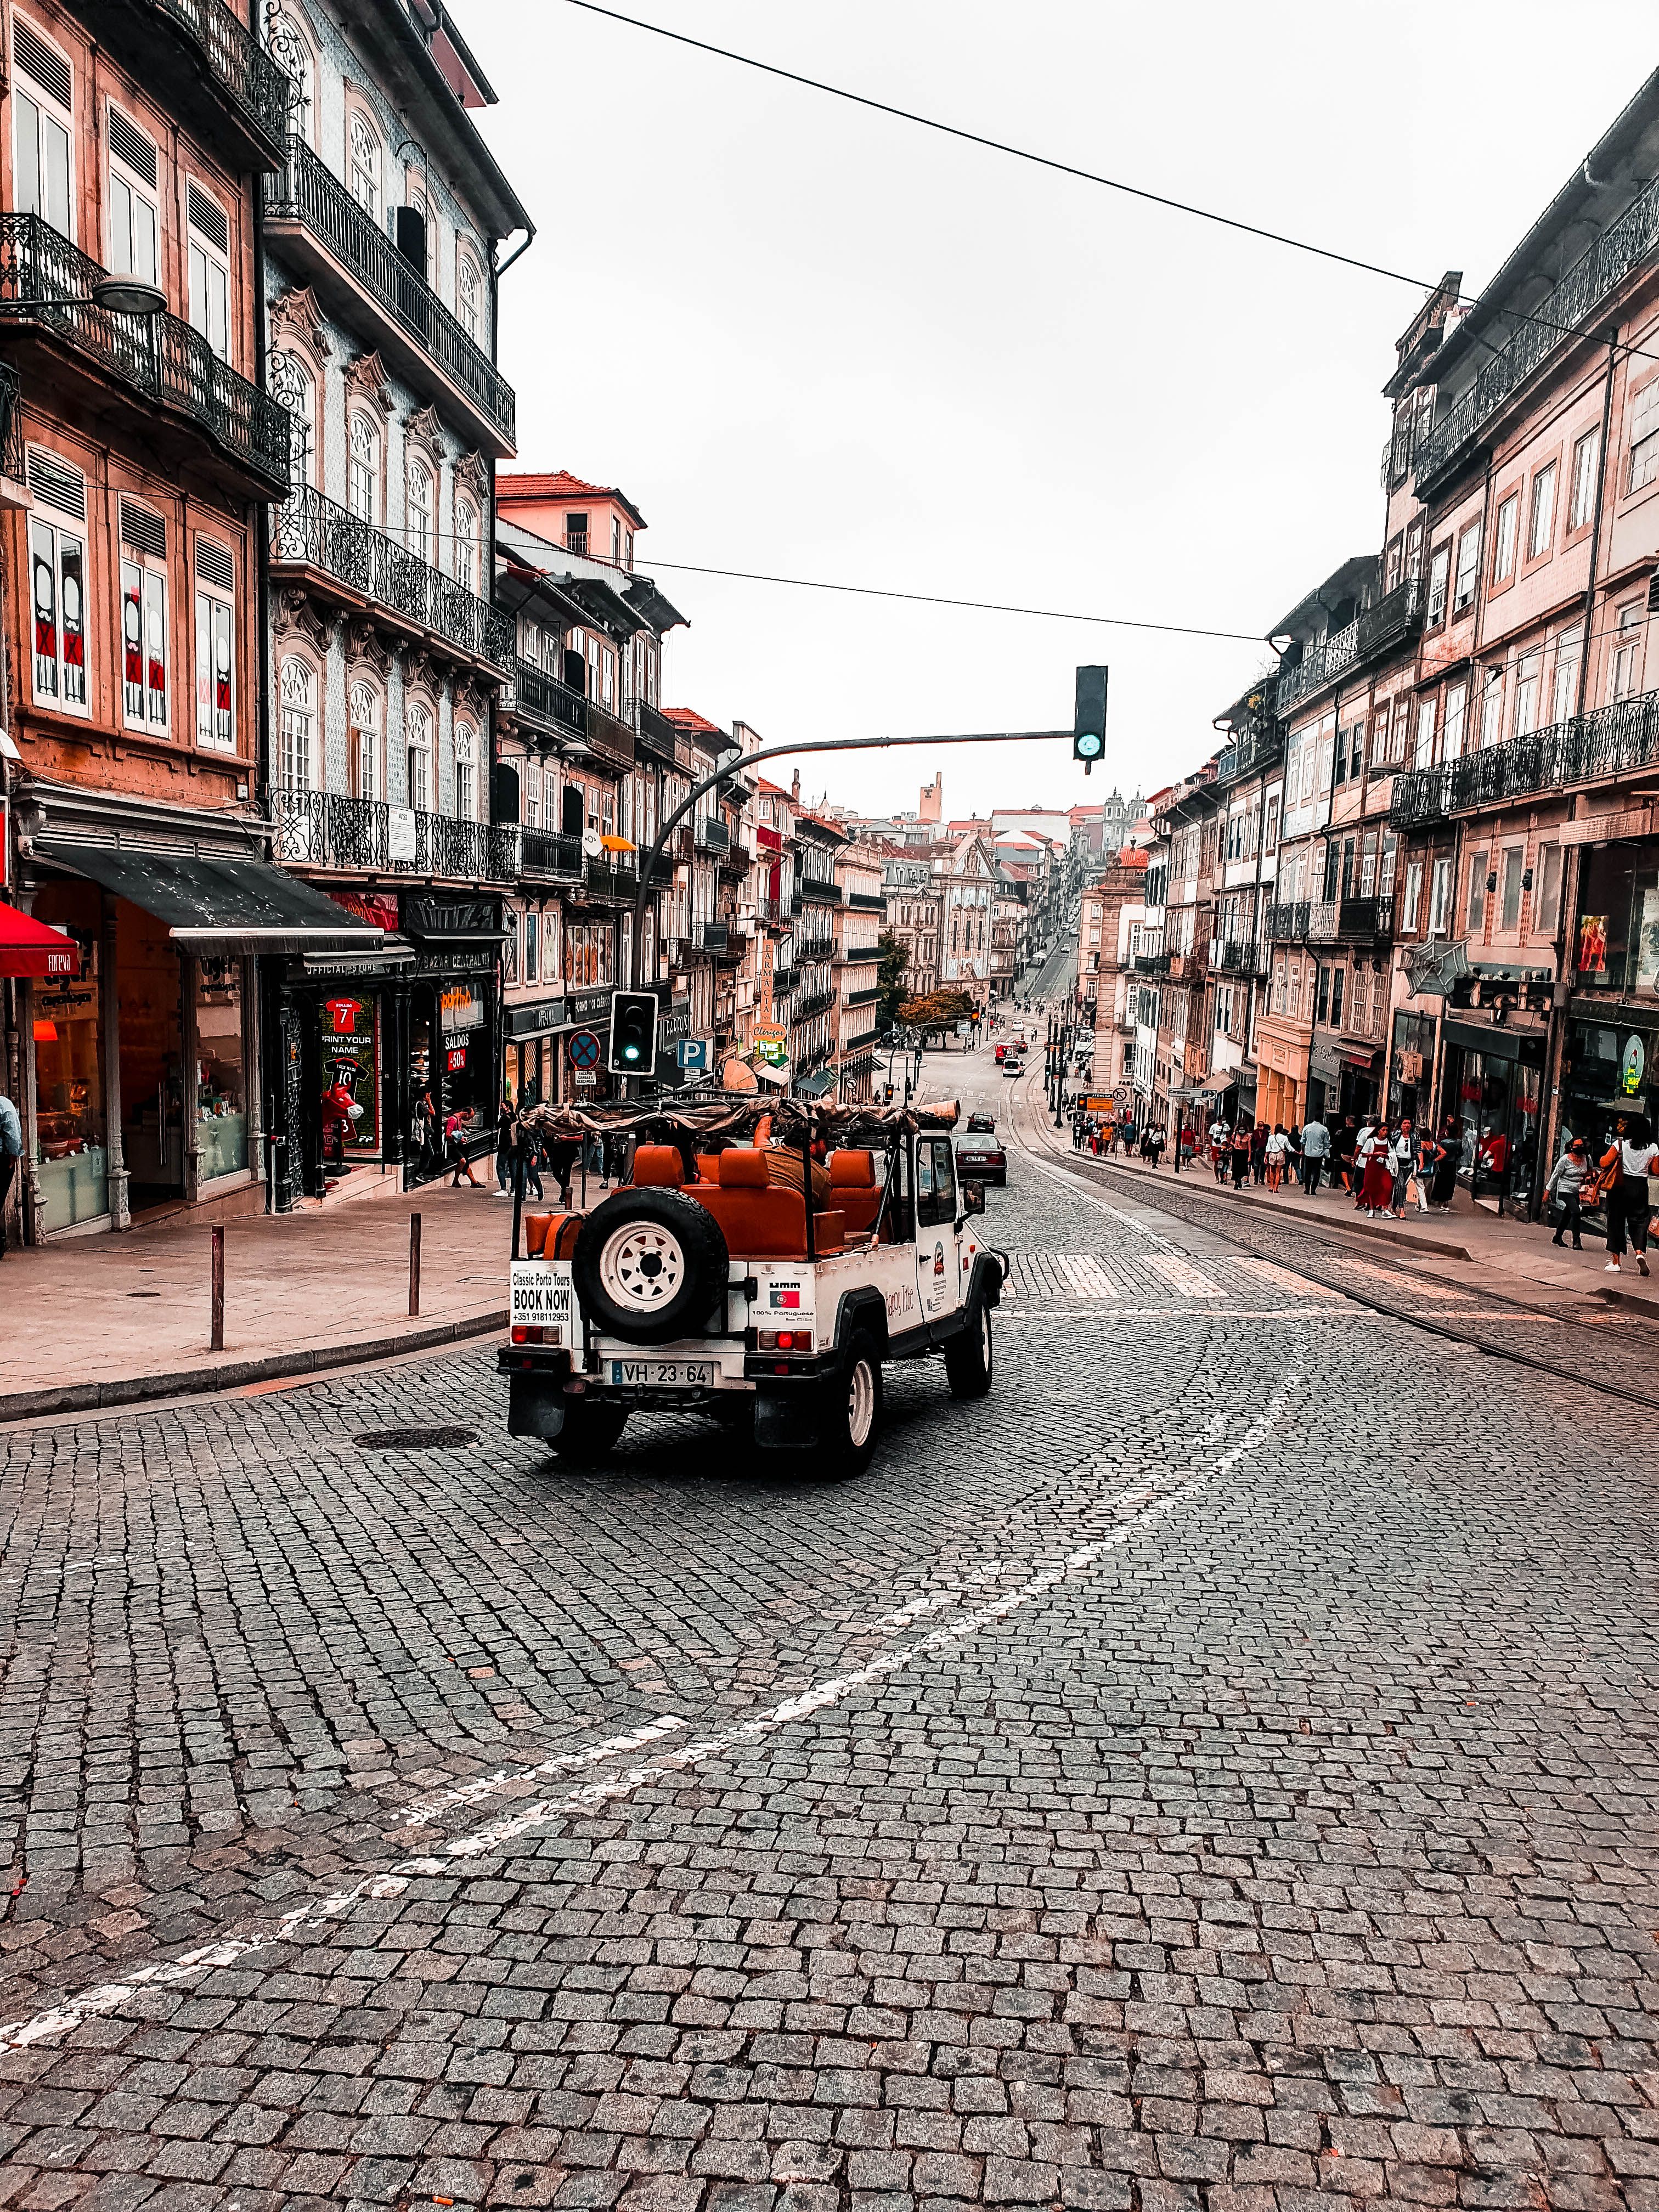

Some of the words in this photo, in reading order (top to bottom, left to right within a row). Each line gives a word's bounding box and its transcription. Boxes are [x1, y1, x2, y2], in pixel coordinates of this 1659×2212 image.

[453, 953, 481, 968] CENTRAL
[763, 944, 771, 1013] FARMÁCIA
[340, 1009, 348, 1024] 7
[445, 1033, 469, 1049] SALDOS
[513, 1273, 534, 1286] Classic
[536, 1273, 552, 1286] Porto
[553, 1273, 570, 1286] Tours
[514, 1289, 543, 1310] BOOK
[546, 1289, 569, 1311] NOW
[885, 1290, 901, 1319] Happy
[514, 1312, 529, 1321] +351
[532, 1312, 569, 1322] 918112953
